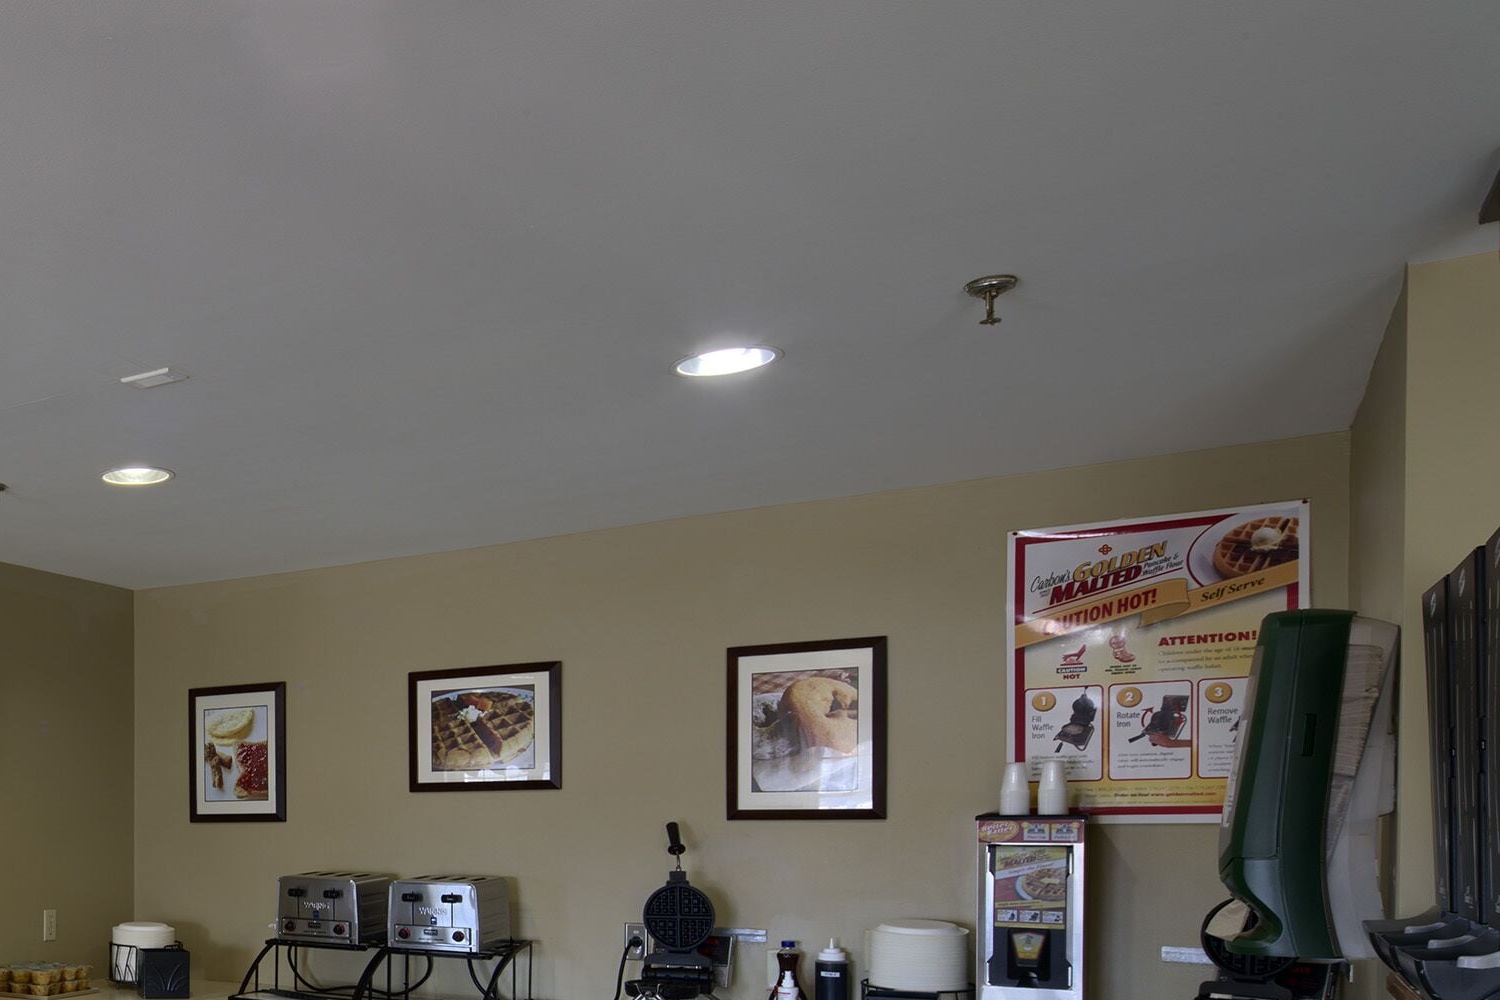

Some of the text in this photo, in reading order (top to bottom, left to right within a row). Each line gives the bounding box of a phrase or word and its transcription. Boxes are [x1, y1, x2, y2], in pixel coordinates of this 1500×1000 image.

[1073, 540, 1168, 582] GOLDEN
[1142, 559, 1184, 576] Waffle Flour
[1143, 555, 1173, 570] Pancake
[1030, 569, 1071, 593] Carbon's
[1049, 564, 1143, 606] MALTED
[1201, 577, 1266, 602] Self Serve
[1117, 588, 1158, 614] HOT!
[1158, 630, 1257, 646] ATTENTION!
[1125, 691, 1134, 702] 2
[1214, 687, 1223, 697] 3
[1116, 711, 1141, 719] Rotate
[1207, 707, 1238, 716] Remove
[1116, 720, 1131, 728] Iron
[1207, 716, 1232, 724] Waffle
